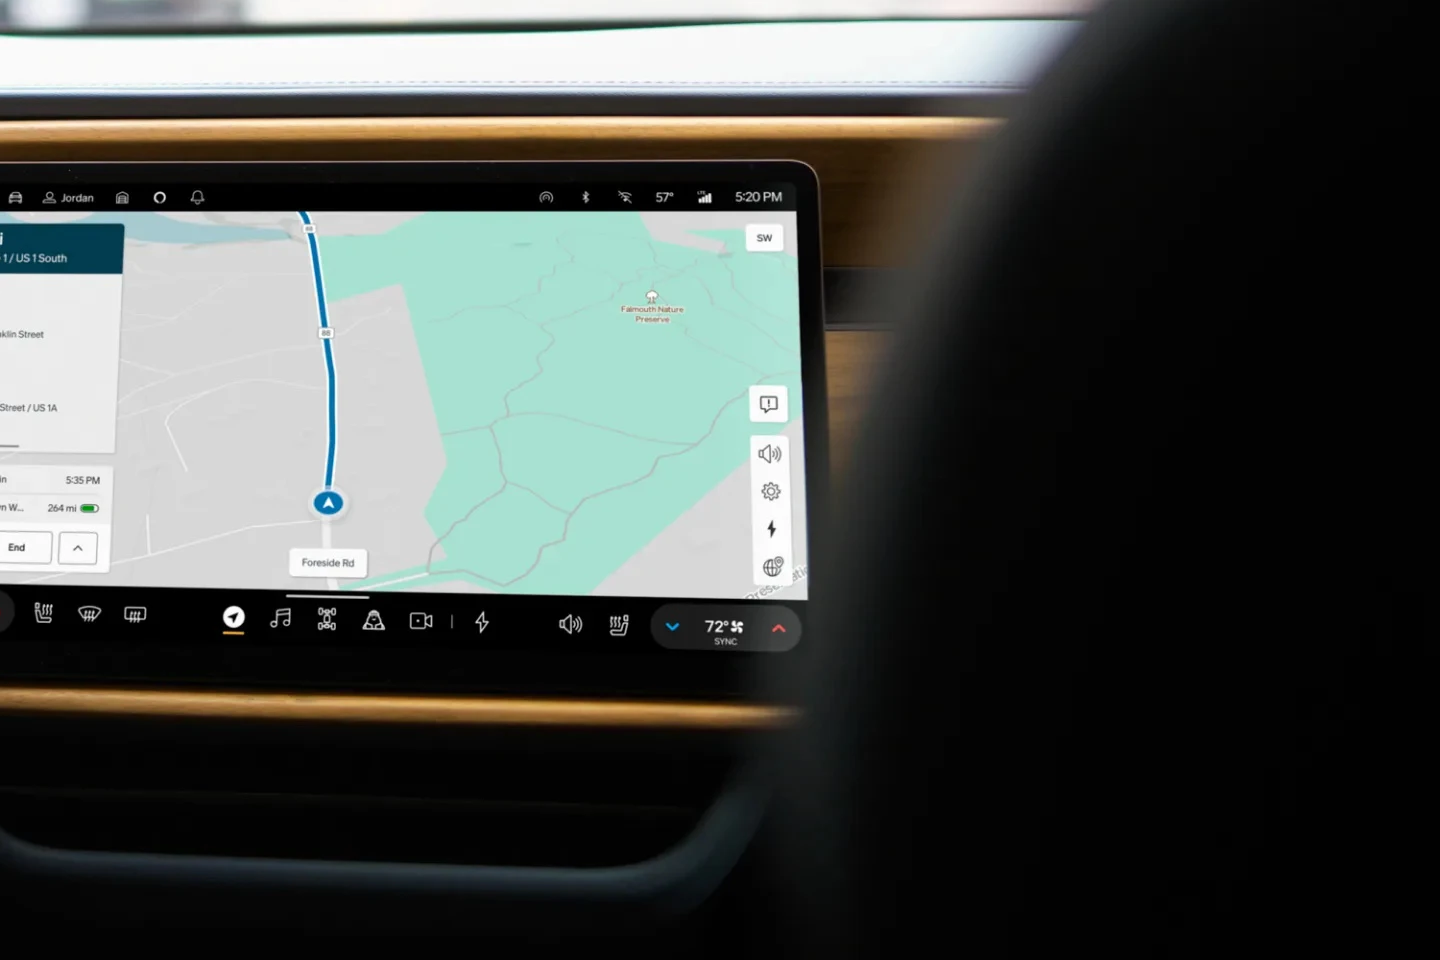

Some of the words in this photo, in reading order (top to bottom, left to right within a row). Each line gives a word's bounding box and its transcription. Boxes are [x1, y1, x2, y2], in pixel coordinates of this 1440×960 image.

[60, 192, 94, 203] Jordan
[655, 192, 674, 203] 57°
[735, 191, 761, 203] 5:20
[763, 191, 783, 202] PM
[756, 233, 773, 243] SW
[3, 253, 8, 263] 1
[15, 253, 31, 263] US
[32, 253, 36, 263] 1
[38, 253, 67, 263] South
[18, 330, 44, 339] Street
[0, 403, 26, 412] Street
[33, 403, 46, 413] US
[47, 403, 58, 413] 1A
[65, 476, 84, 485] 5:35
[85, 476, 101, 485] PM
[47, 504, 64, 513] 264
[65, 504, 77, 513] mi
[8, 543, 25, 552] End
[301, 558, 341, 568] Foreside
[342, 558, 355, 568] Rd
[705, 620, 729, 634] 72°
[714, 638, 738, 646] SYNC
